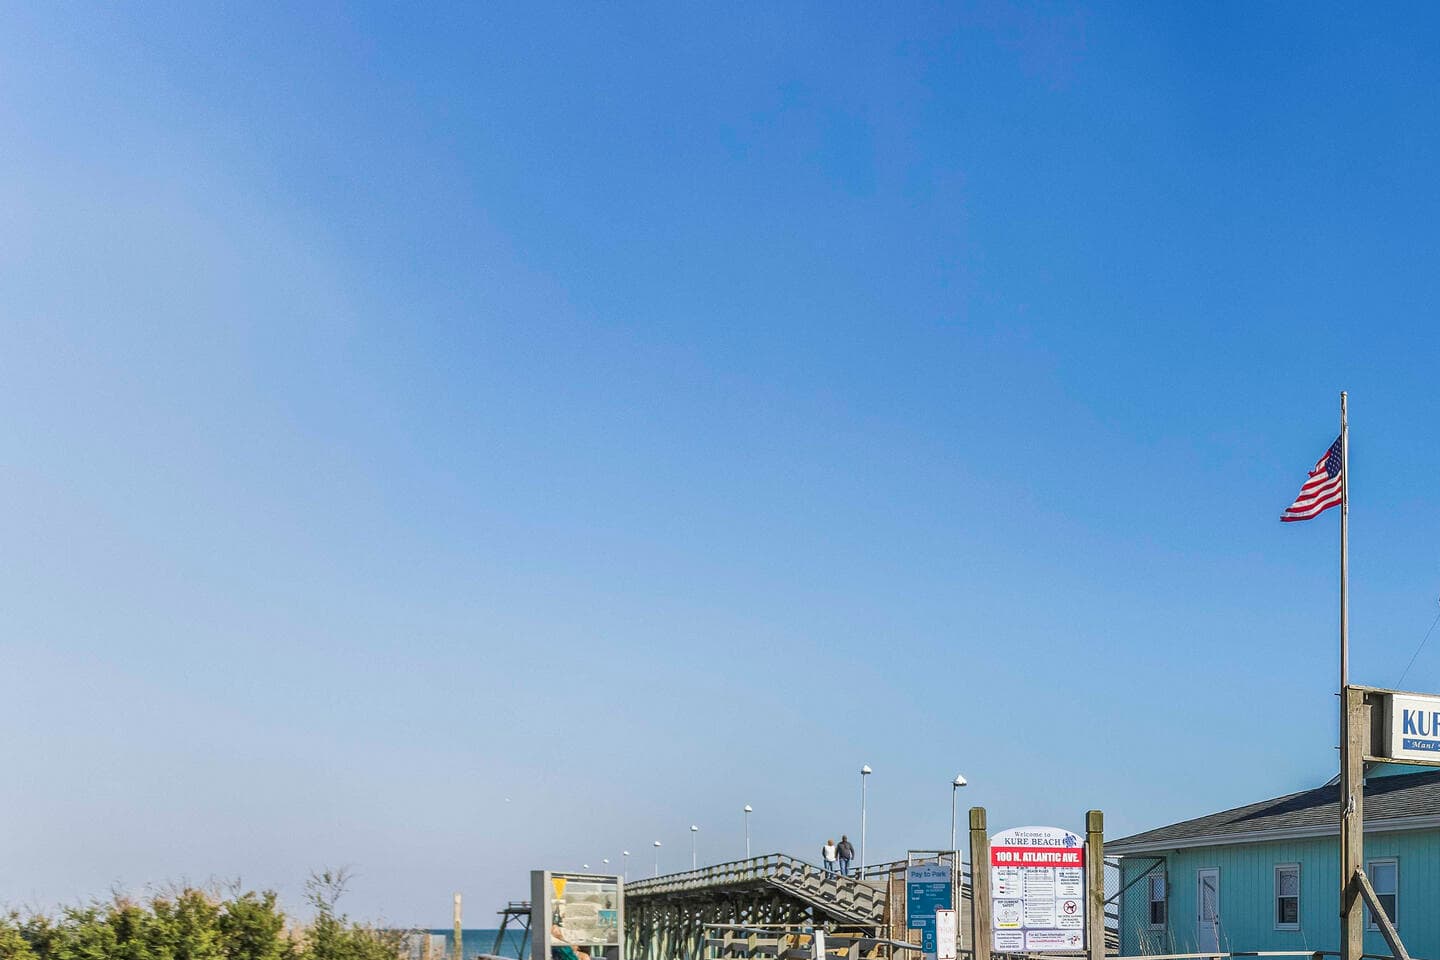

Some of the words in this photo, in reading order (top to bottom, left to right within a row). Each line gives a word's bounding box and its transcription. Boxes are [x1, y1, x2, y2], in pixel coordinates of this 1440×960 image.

[1031, 838, 1061, 846] BEACH
[995, 852, 1012, 862] 100
[1013, 852, 1022, 862] N.
[1022, 852, 1061, 862] ATLANTIC
[1062, 853, 1080, 863] AVE.
[910, 871, 922, 879] Pay
